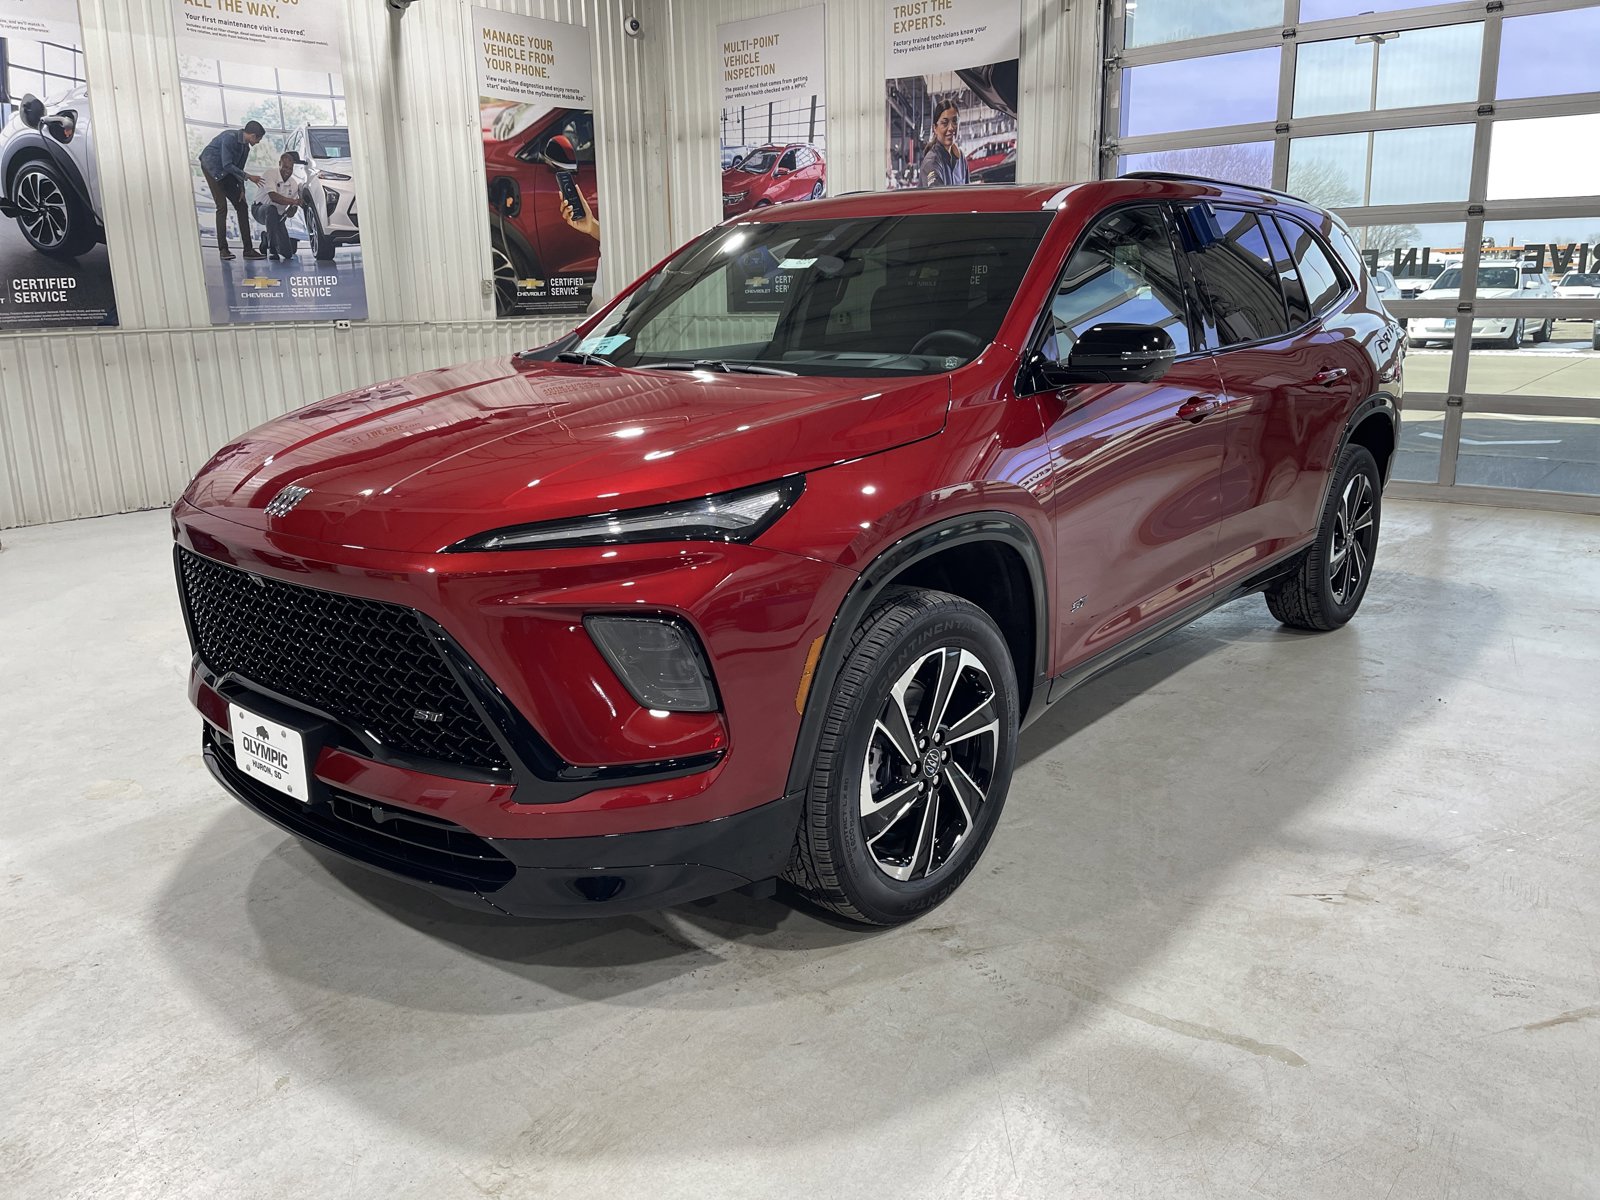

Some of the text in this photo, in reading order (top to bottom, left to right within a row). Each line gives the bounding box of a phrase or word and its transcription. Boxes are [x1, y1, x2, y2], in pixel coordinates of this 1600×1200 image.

[216, 0, 242, 13] THE
[246, 2, 280, 19] WAY.
[893, 0, 952, 18] TRUST THE
[185, 12, 200, 22] Your
[202, 16, 216, 24] first
[218, 19, 258, 30] maintenance
[259, 24, 272, 32] visit
[894, 14, 946, 34] EXPERTS.
[483, 28, 553, 51] MANAGE YOUR
[912, 36, 930, 44] trained
[931, 32, 960, 40] technicians
[974, 26, 987, 34] your
[956, 36, 975, 45] anyone.
[724, 34, 780, 54] MULTI-POINT
[484, 42, 554, 66] VEHICLE FROM
[724, 52, 760, 68] VEHICLE
[485, 57, 550, 78] YOUR PHONE.
[724, 64, 776, 81] INSPECTION
[498, 77, 519, 86] real-time
[520, 80, 544, 90] diagnostics
[553, 86, 564, 94] enjoy
[793, 76, 808, 84] getting
[535, 90, 561, 99] myChevrolet
[12, 278, 76, 290] CERTIFIED
[290, 276, 338, 286] CERTIFIED
[550, 278, 584, 286] CERTIFIED
[14, 291, 68, 304] SERVICE
[292, 288, 332, 298] SERVICE
[550, 287, 579, 296] SERVICE
[243, 736, 288, 770] OLYMPIC
[252, 760, 282, 780] HURON, SD
